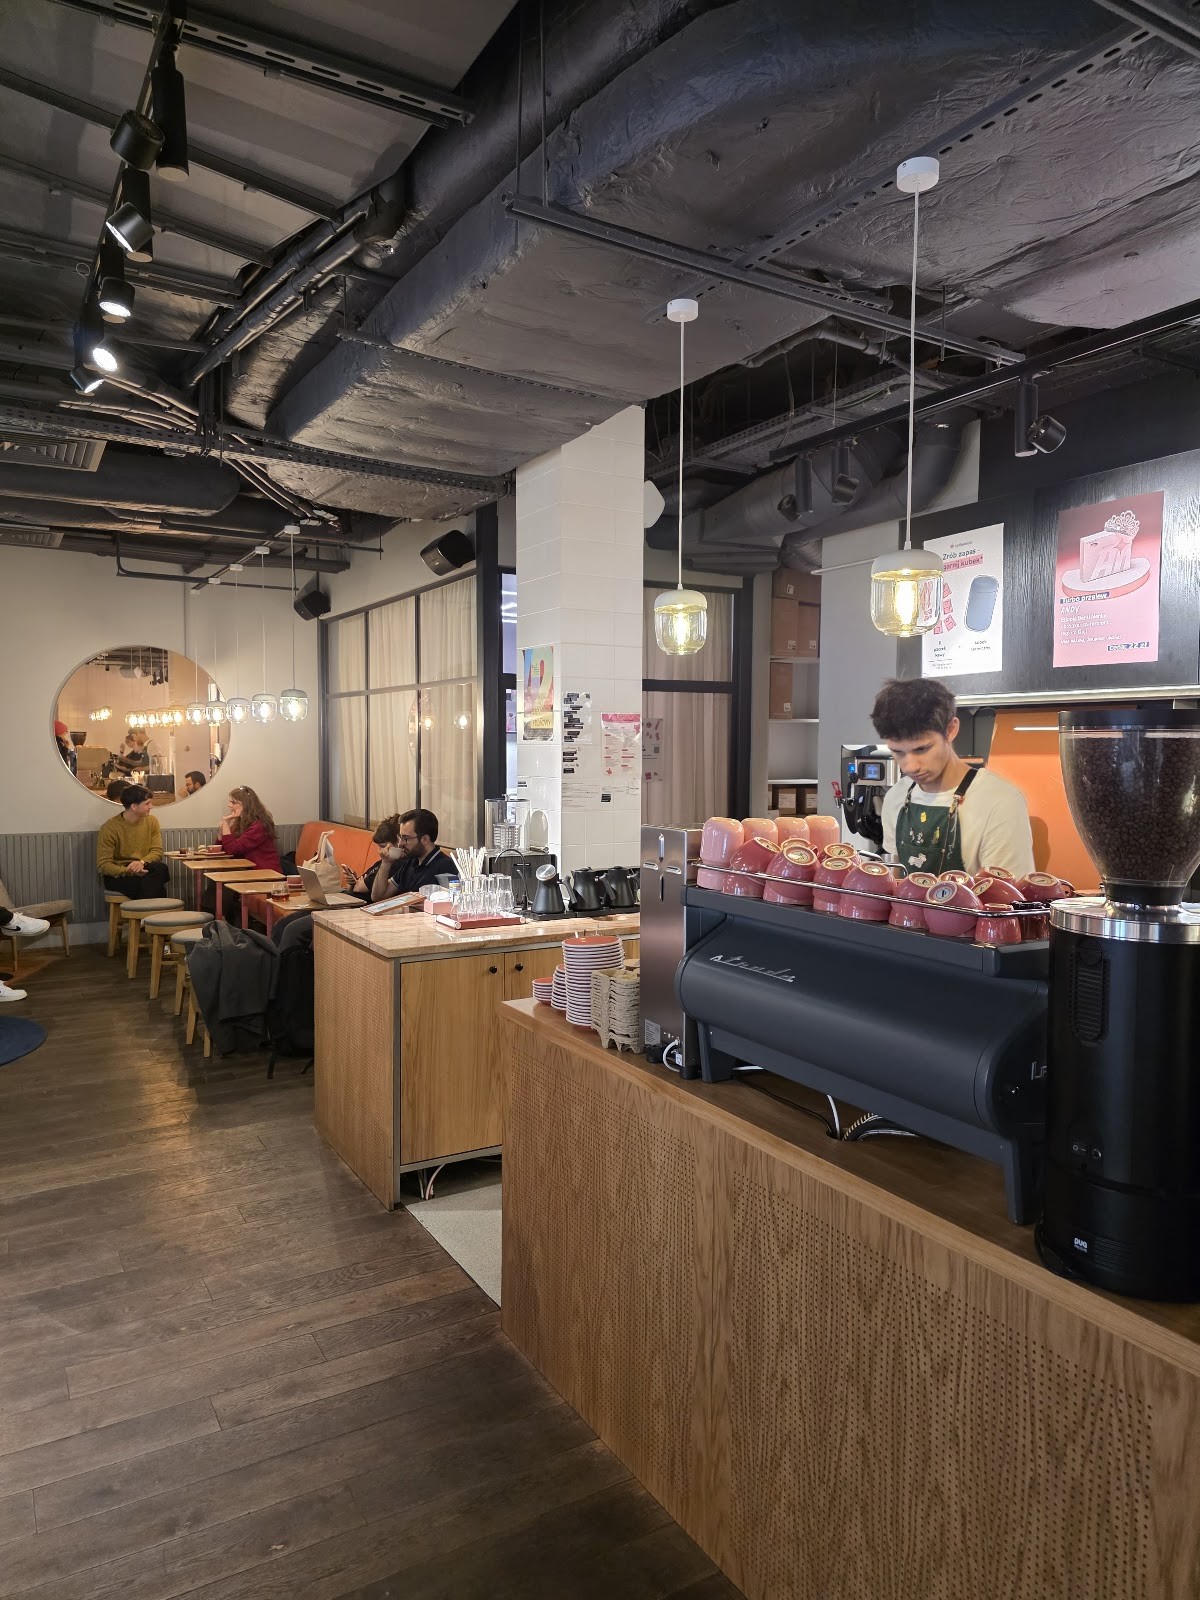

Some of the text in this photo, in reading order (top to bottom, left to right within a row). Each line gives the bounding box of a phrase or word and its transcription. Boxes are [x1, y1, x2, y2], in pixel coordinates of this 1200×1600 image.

[943, 551, 957, 560] Zrób
[959, 549, 976, 558] zapas
[943, 560, 960, 571] garnij
[1064, 593, 1107, 604] Turbo przelew
[1060, 605, 1080, 614] ANDY
